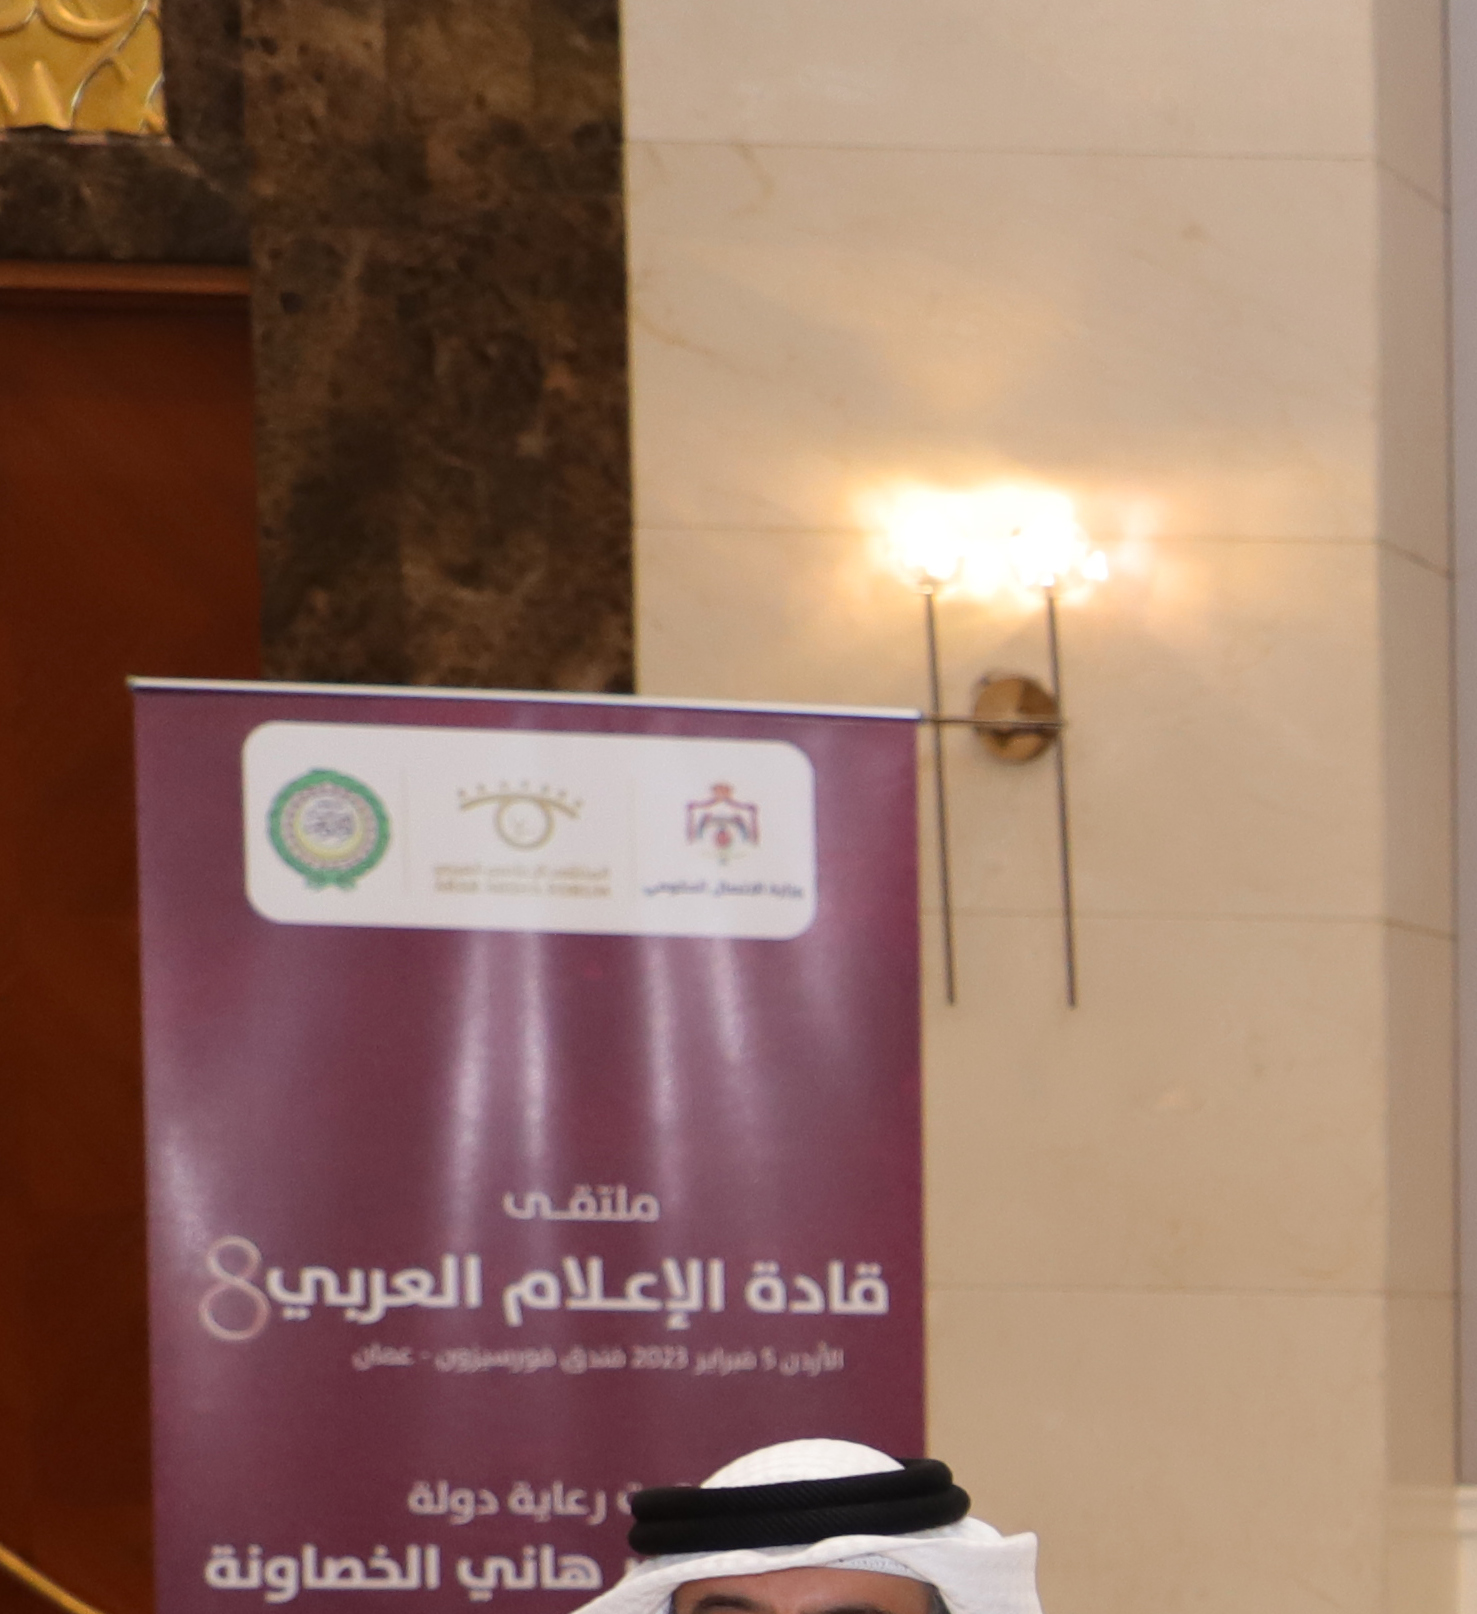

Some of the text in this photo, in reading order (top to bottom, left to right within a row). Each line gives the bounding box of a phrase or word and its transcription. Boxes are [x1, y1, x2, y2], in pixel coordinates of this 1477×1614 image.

[201, 1236, 270, 1341] 8
[266, 1254, 890, 1328] قادة الإعلام العربي
[631, 1345, 689, 1371] 2023
[761, 1346, 777, 1371] 5
[407, 1481, 500, 1525] دولة
[508, 1481, 607, 1525] رعاية
[204, 1543, 441, 1604] الخصاونة
[456, 1544, 603, 1602] هاني
